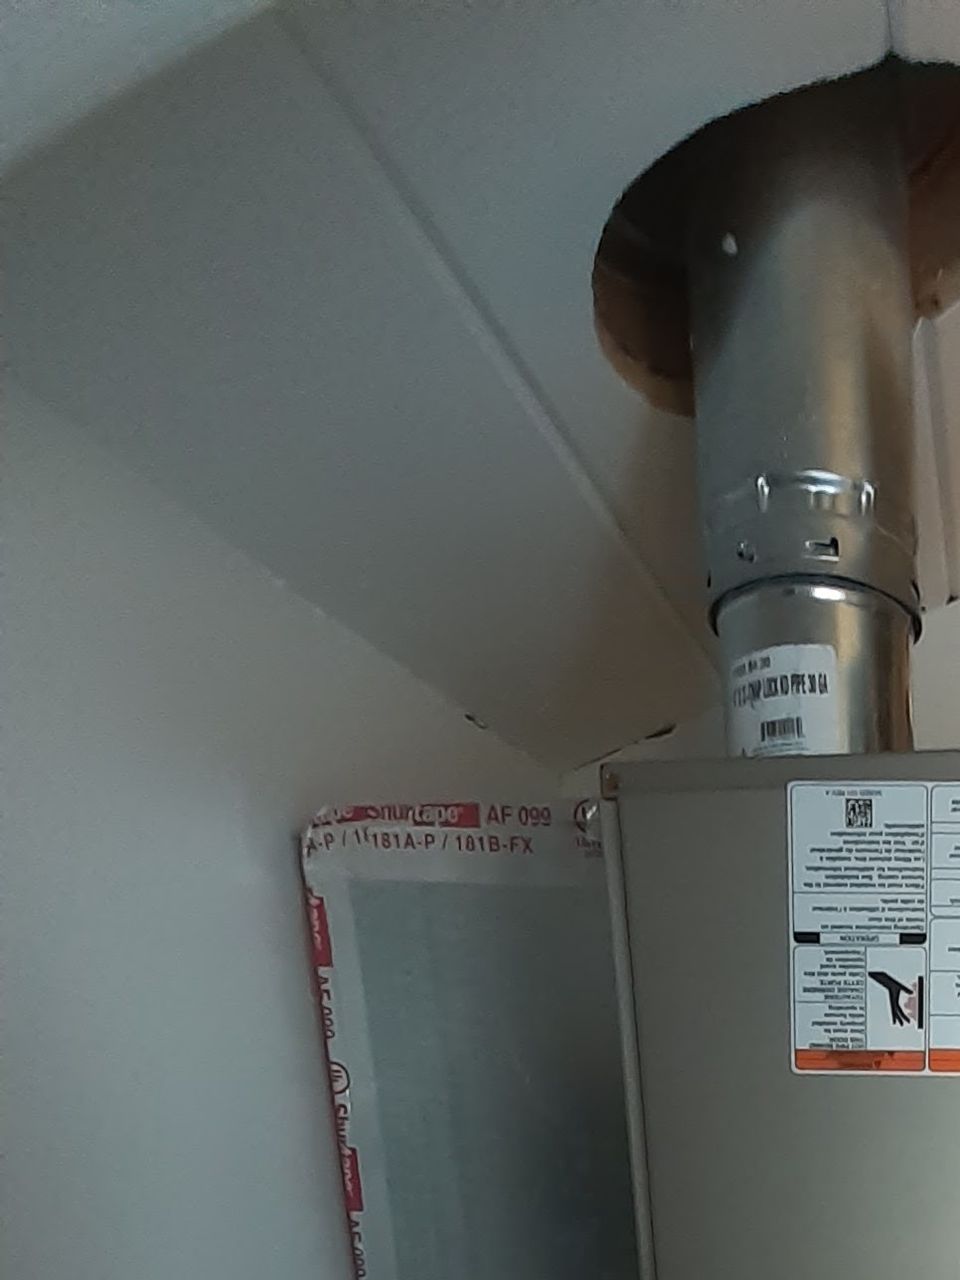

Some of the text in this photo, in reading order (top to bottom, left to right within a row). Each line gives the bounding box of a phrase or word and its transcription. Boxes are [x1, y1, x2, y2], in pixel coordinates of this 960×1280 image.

[791, 673, 806, 694] PIPE
[808, 674, 817, 693] 30
[818, 673, 828, 694] GA
[487, 805, 512, 822] AF
[519, 806, 552, 827] 099
[372, 833, 436, 850] 181A-P
[457, 835, 534, 858] 181B-FX
